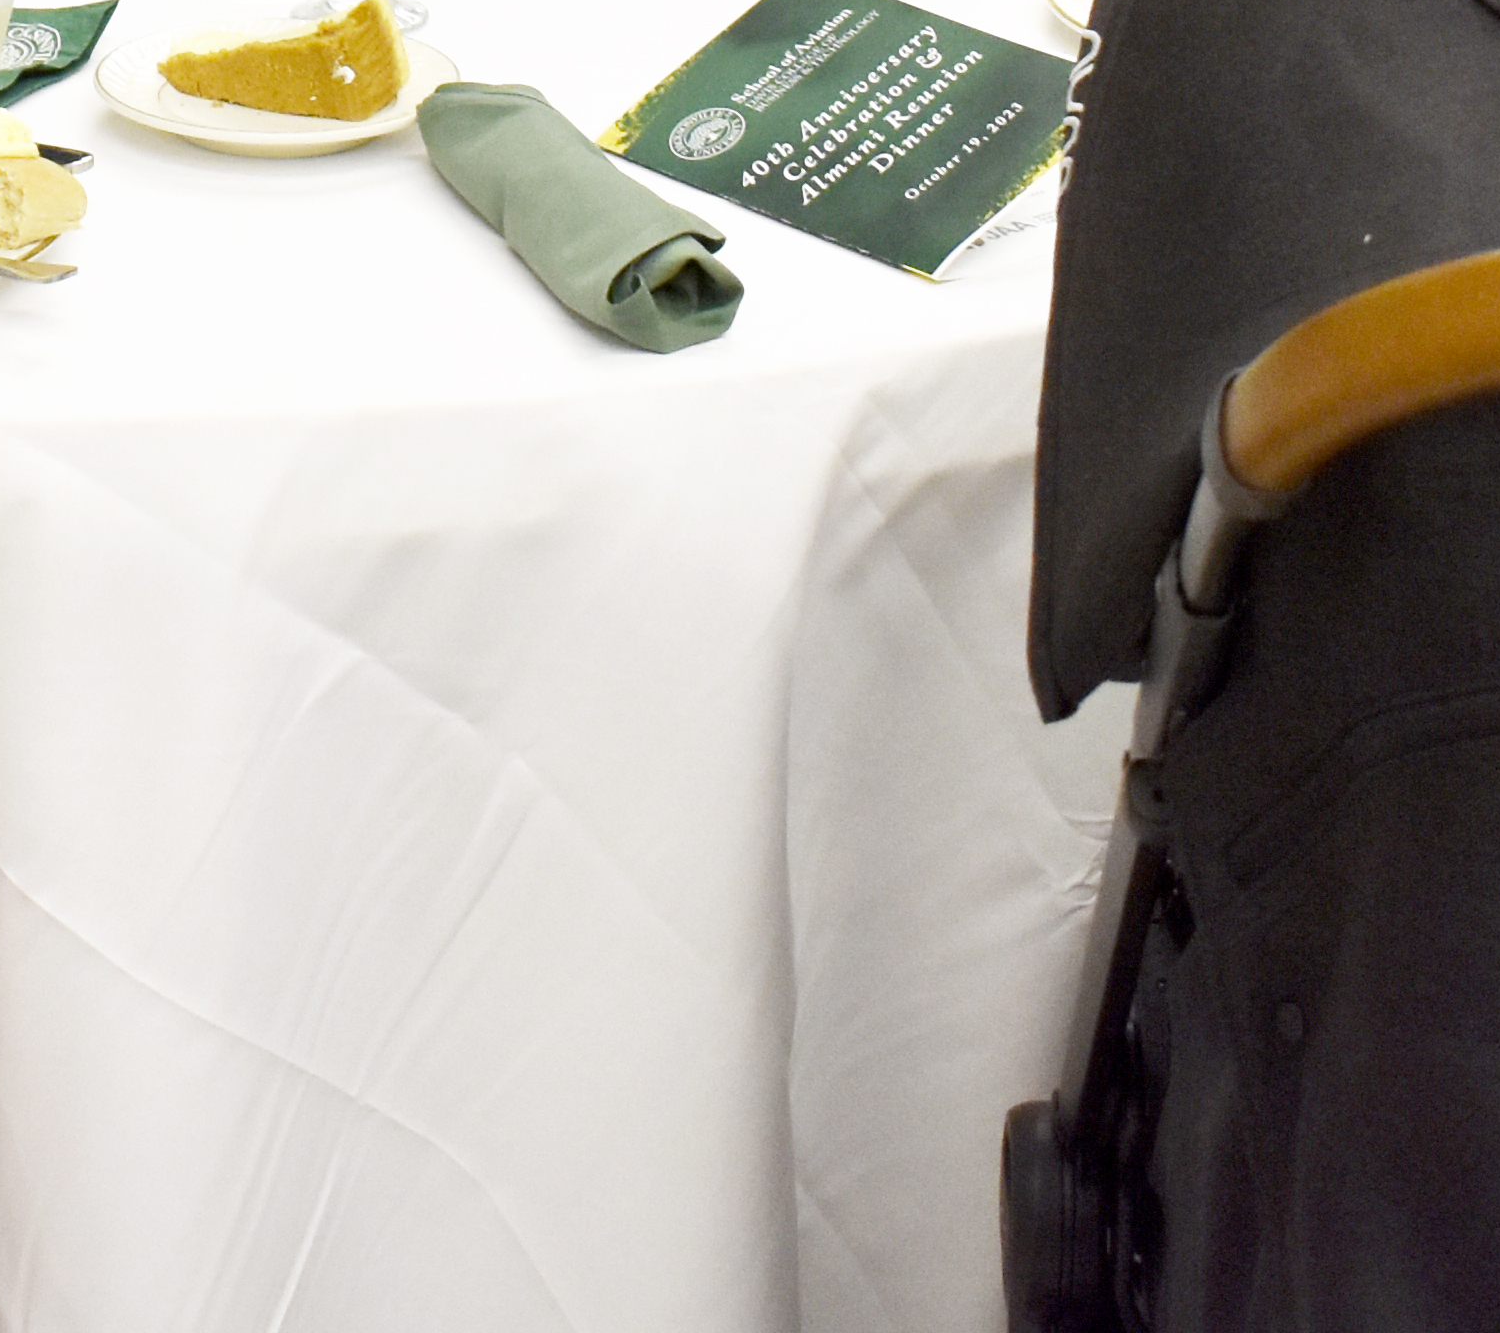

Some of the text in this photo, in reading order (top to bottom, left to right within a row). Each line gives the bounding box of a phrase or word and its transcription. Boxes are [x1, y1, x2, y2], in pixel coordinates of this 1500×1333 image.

[731, 8, 854, 104] School of Aviation
[742, 25, 938, 187] 40th Anniversary
[783, 47, 943, 181] Celebration &
[801, 49, 984, 206] Almuni Reunion
[867, 102, 954, 175] Dinner
[904, 101, 1024, 200] October 19, 2023
